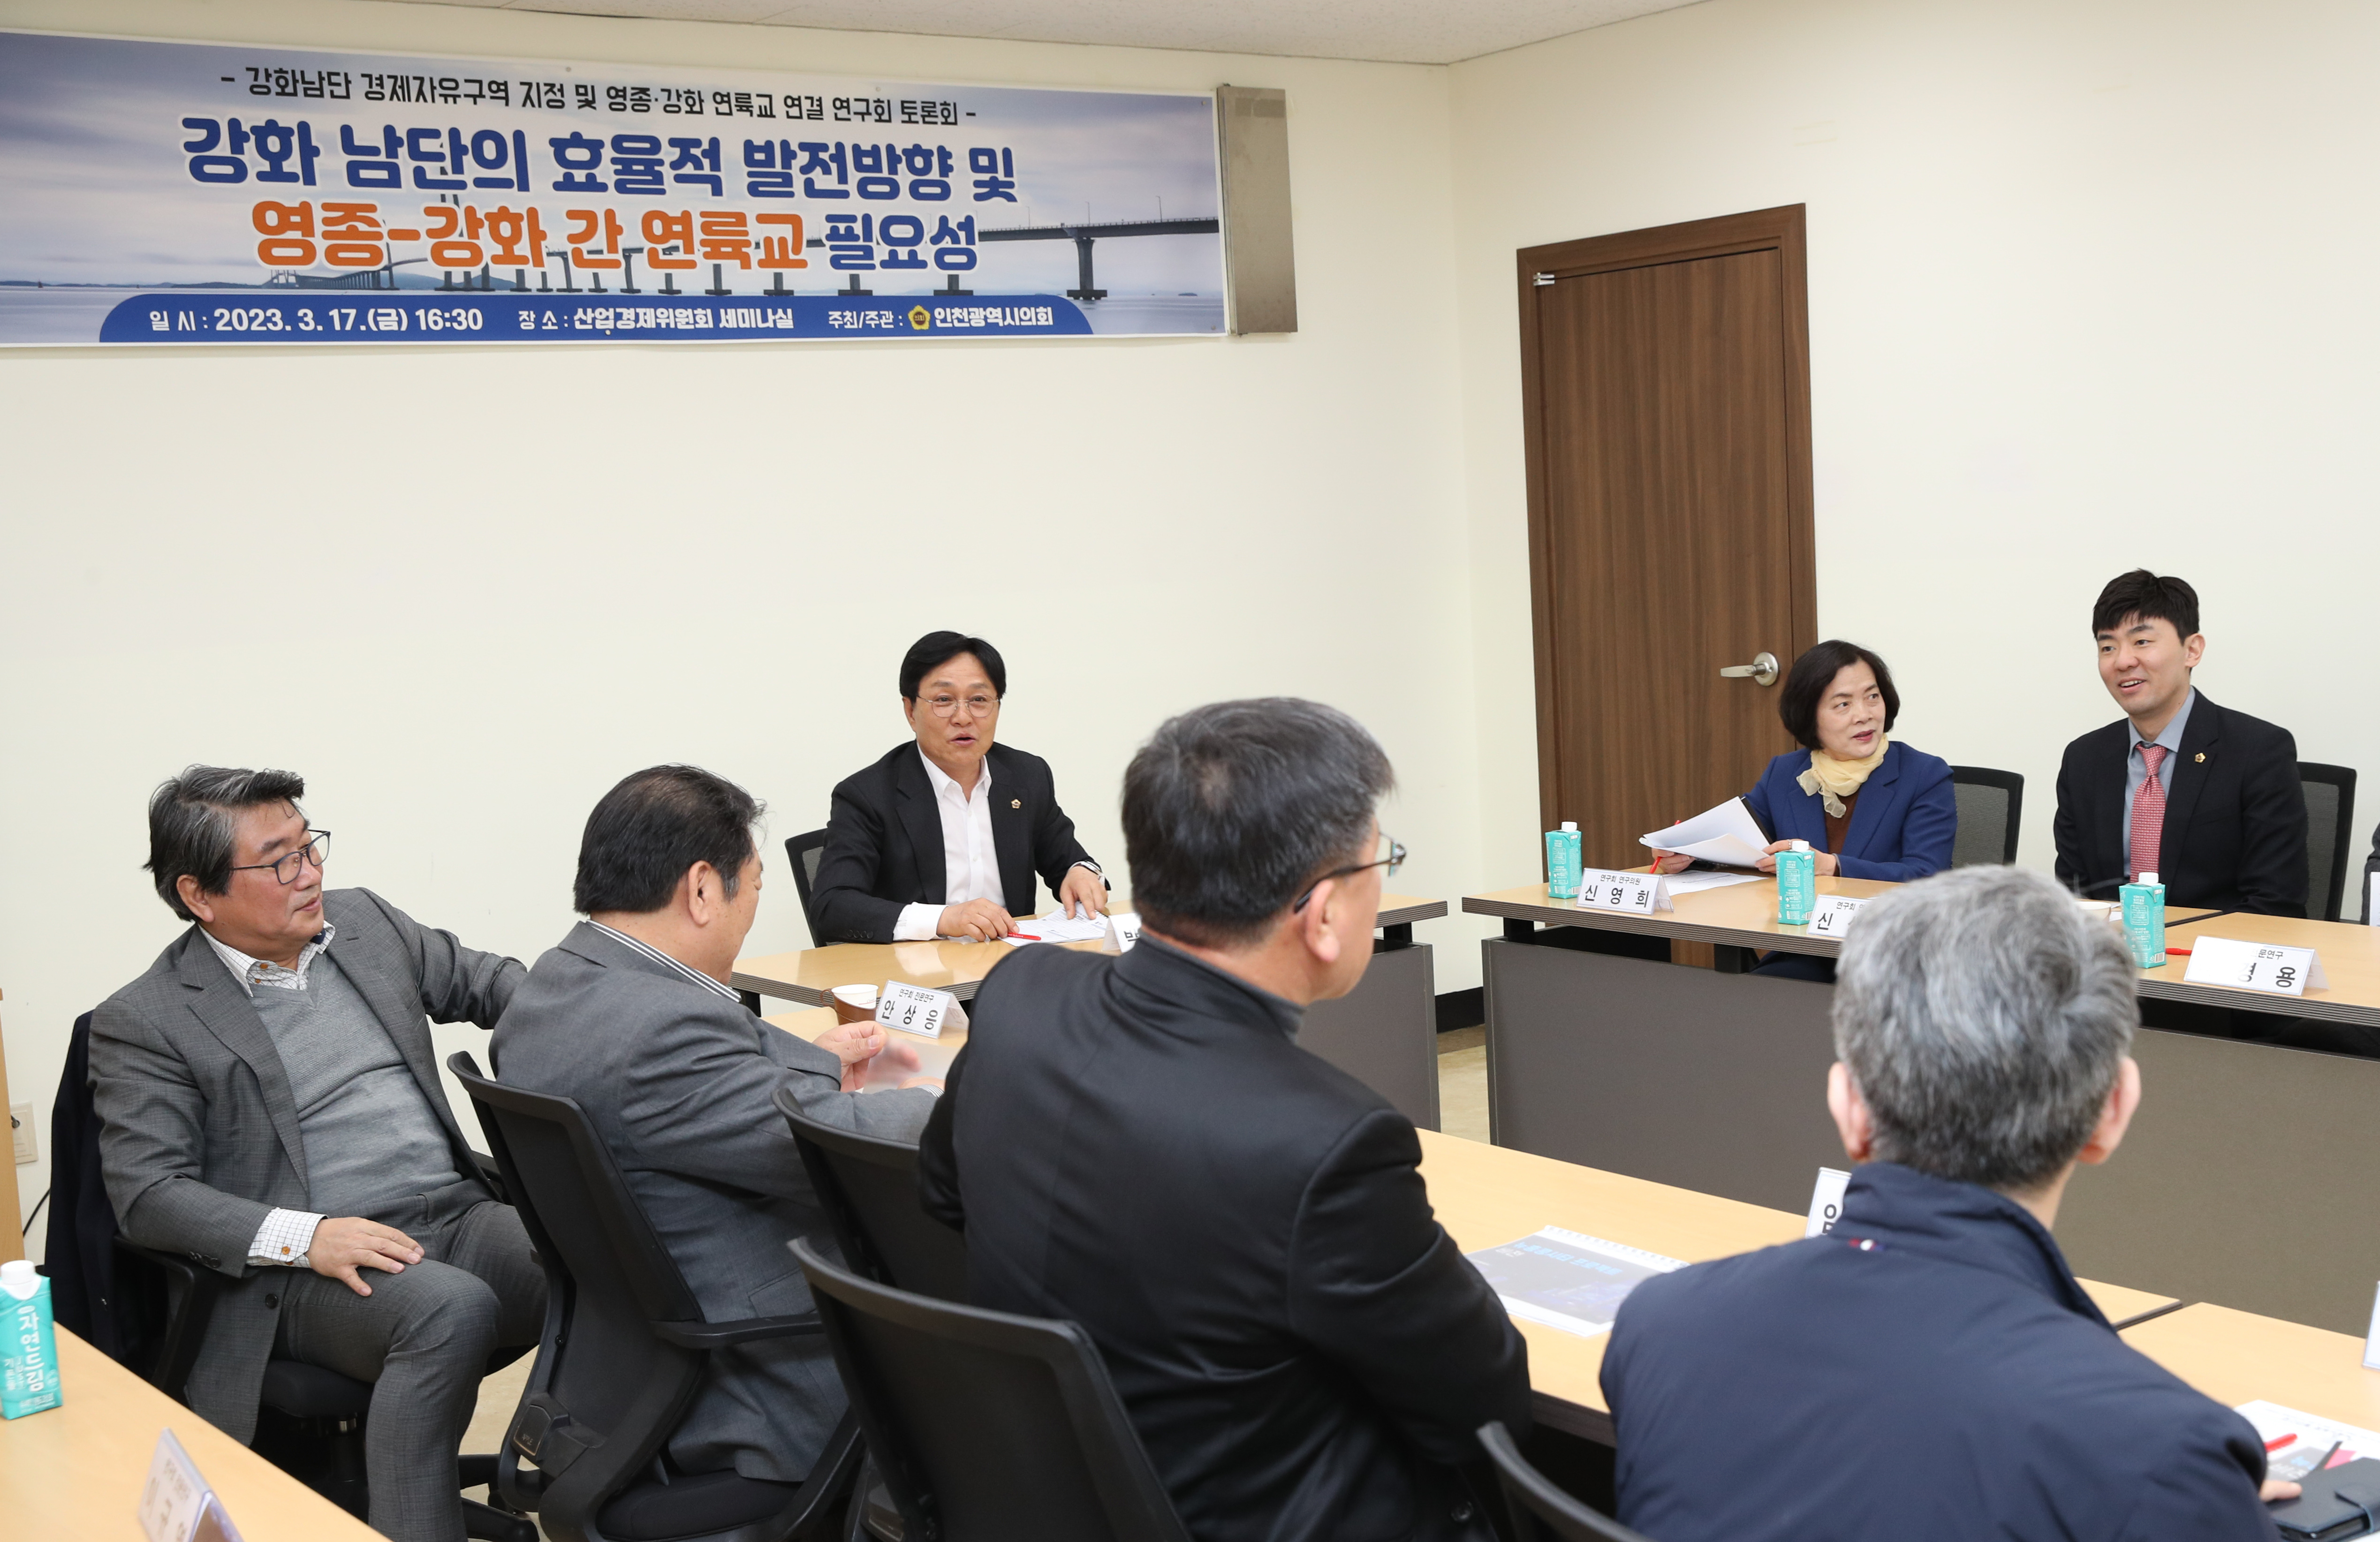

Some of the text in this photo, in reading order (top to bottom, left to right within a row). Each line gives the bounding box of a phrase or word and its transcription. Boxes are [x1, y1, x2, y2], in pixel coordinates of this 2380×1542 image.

[245, 67, 352, 99] 강화남단
[361, 73, 509, 106] 경제자유구역
[519, 82, 565, 109] 지정
[575, 84, 597, 110] 및
[606, 86, 705, 114] 영종·강화
[712, 91, 776, 118] 연륙교
[784, 95, 824, 121] 연결
[833, 97, 892, 123] 연구회
[901, 100, 958, 126] 토론회
[183, 118, 1017, 202] 강화 남단의 효율적 발전방향 및
[252, 200, 977, 271] 영종-강화 간 연륙교 필요성
[214, 308, 291, 331] 2023.
[297, 309, 323, 331] 3.
[329, 308, 408, 331] 17.(금)
[415, 308, 483, 330] 16:30
[574, 308, 713, 329] 산업경제위원회
[719, 308, 794, 329] 세미나실
[828, 310, 894, 329] 주최/주관
[934, 306, 1053, 327] 인천광역시의회
[1600, 874, 1641, 885] 연구회 연구의원
[1585, 885, 1650, 908] 신 영 희
[1836, 901, 1856, 911] 연구회
[1817, 913, 1834, 930] 신
[2276, 967, 2296, 988] 용
[899, 988, 934, 1003] 연구회 전문연구
[882, 1000, 895, 1020] 안
[903, 1005, 917, 1025] 상
[19, 1311, 45, 1392] 자연드림
